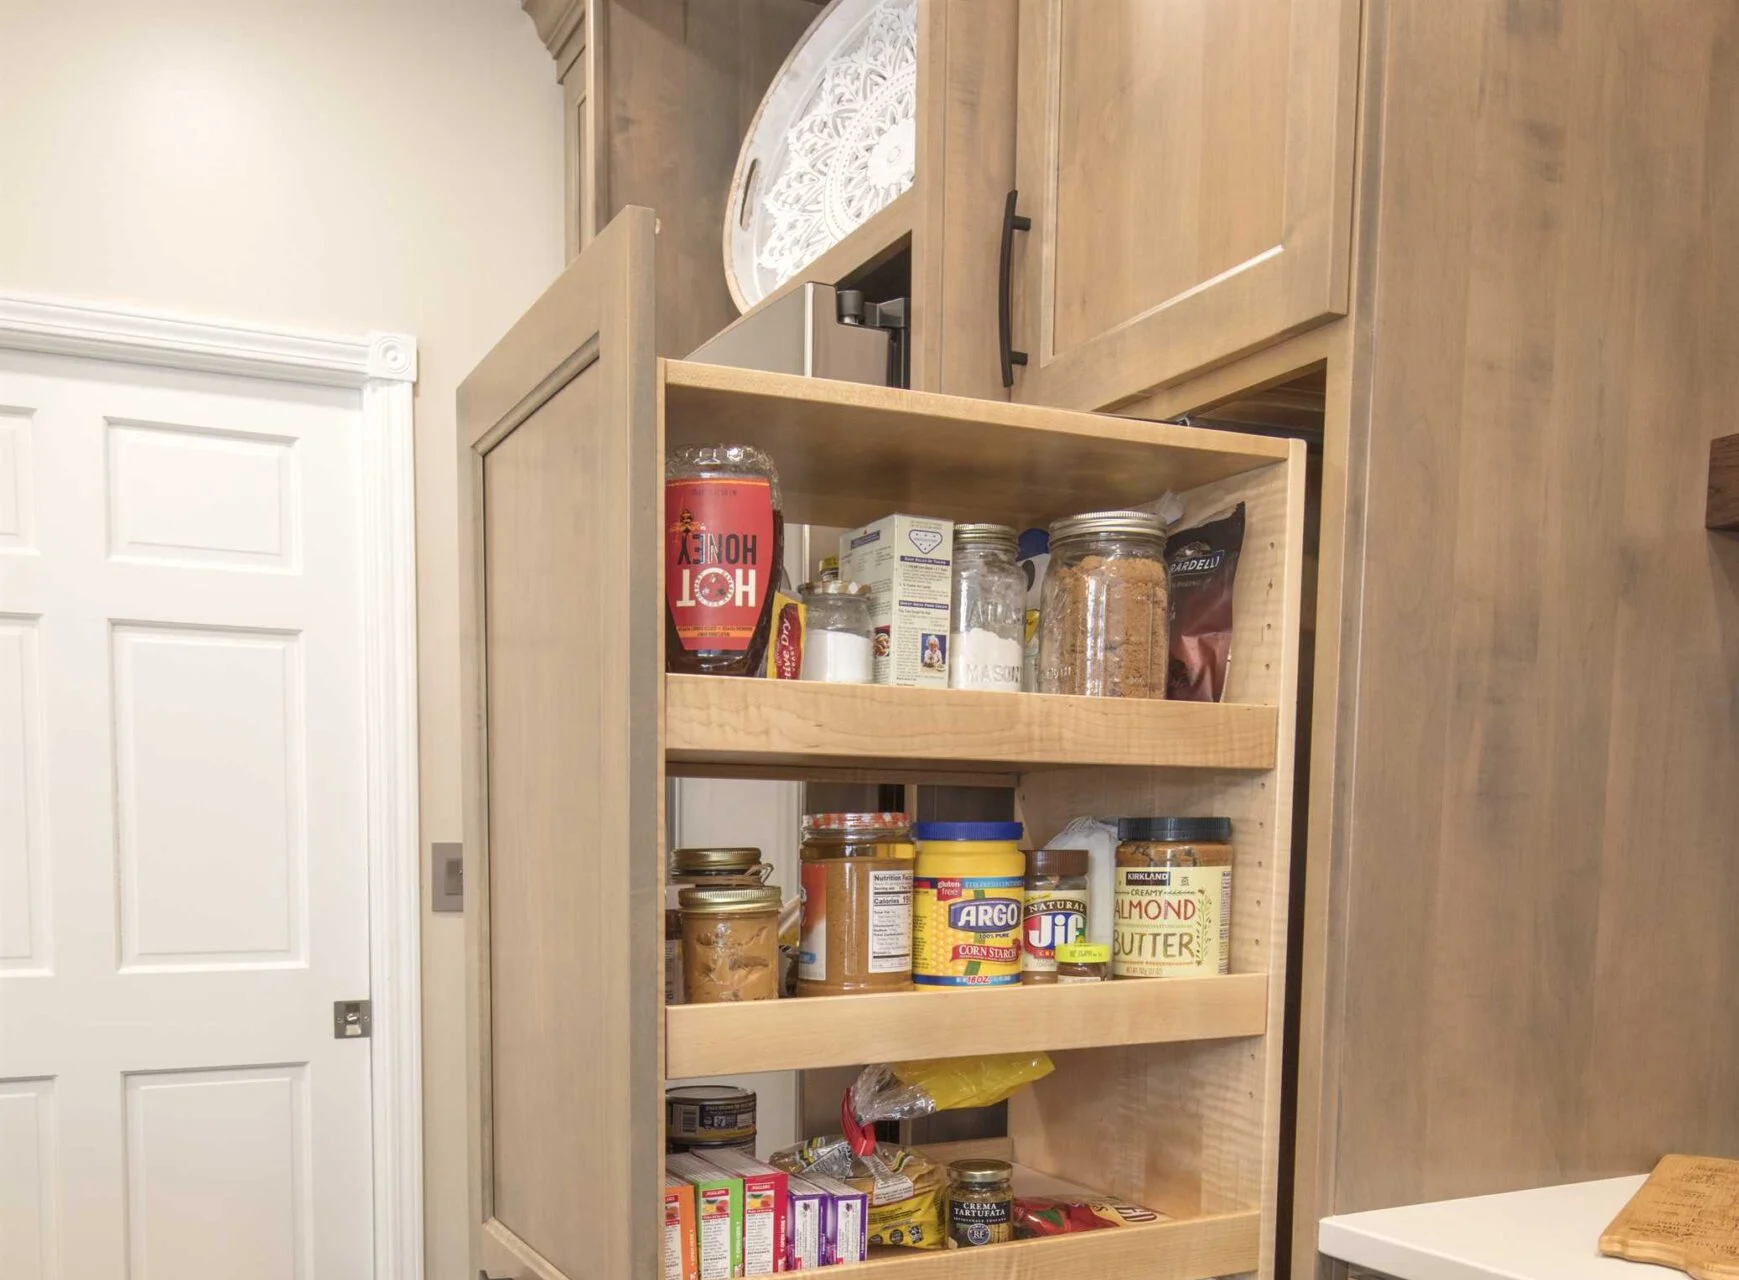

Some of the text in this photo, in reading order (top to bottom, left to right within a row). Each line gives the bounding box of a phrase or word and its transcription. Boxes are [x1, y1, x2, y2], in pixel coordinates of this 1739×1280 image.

[677, 534, 757, 565] HONEY
[676, 567, 757, 608] HOT
[781, 618, 792, 680] tive Dry
[966, 664, 1022, 683] MASON
[1128, 872, 1168, 880] KIRKLAND
[942, 887, 958, 896] free
[1130, 889, 1163, 897] CREAMY
[958, 904, 1018, 927] ARGO
[1029, 901, 1084, 913] NATURAL
[1115, 899, 1196, 920] ALMOND
[1028, 914, 1084, 948] Jif
[959, 945, 1017, 960] CORN STARCH
[1113, 929, 1195, 959] BUTTER
[954, 1207, 1005, 1217] TARTUFATA
